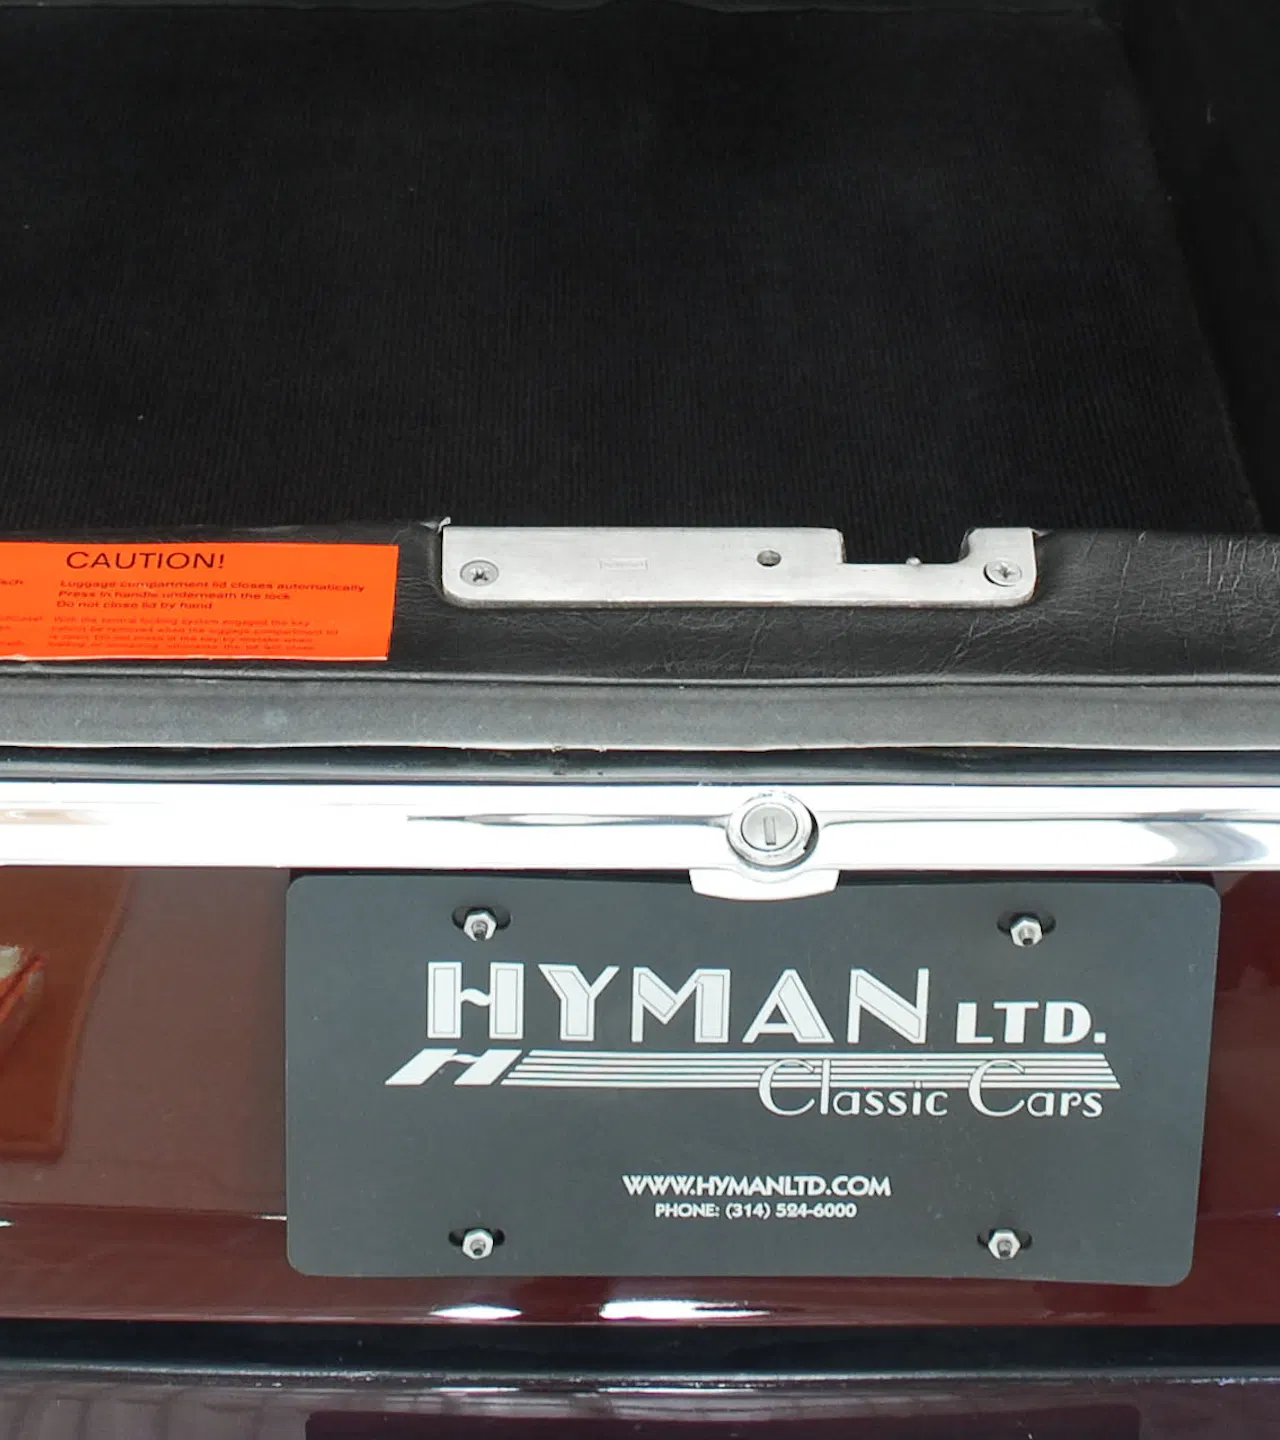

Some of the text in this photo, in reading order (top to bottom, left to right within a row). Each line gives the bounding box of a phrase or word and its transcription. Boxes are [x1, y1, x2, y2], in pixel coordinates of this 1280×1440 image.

[65, 551, 226, 570] CAUTION!
[59, 579, 365, 592] Luggage compartment lid closes automatically
[58, 590, 96, 598] Press
[99, 590, 112, 598] in
[162, 591, 237, 600] underneath
[264, 592, 291, 600] lock
[56, 600, 213, 610] Do not close lid by hand
[426, 961, 1108, 1045] HYMAN LTD.
[758, 1058, 1104, 1118] Classic Cars
[622, 1175, 892, 1197] WWW.HYMANLTD.COM
[655, 1202, 858, 1220] PHONE: (314) 524-6000
